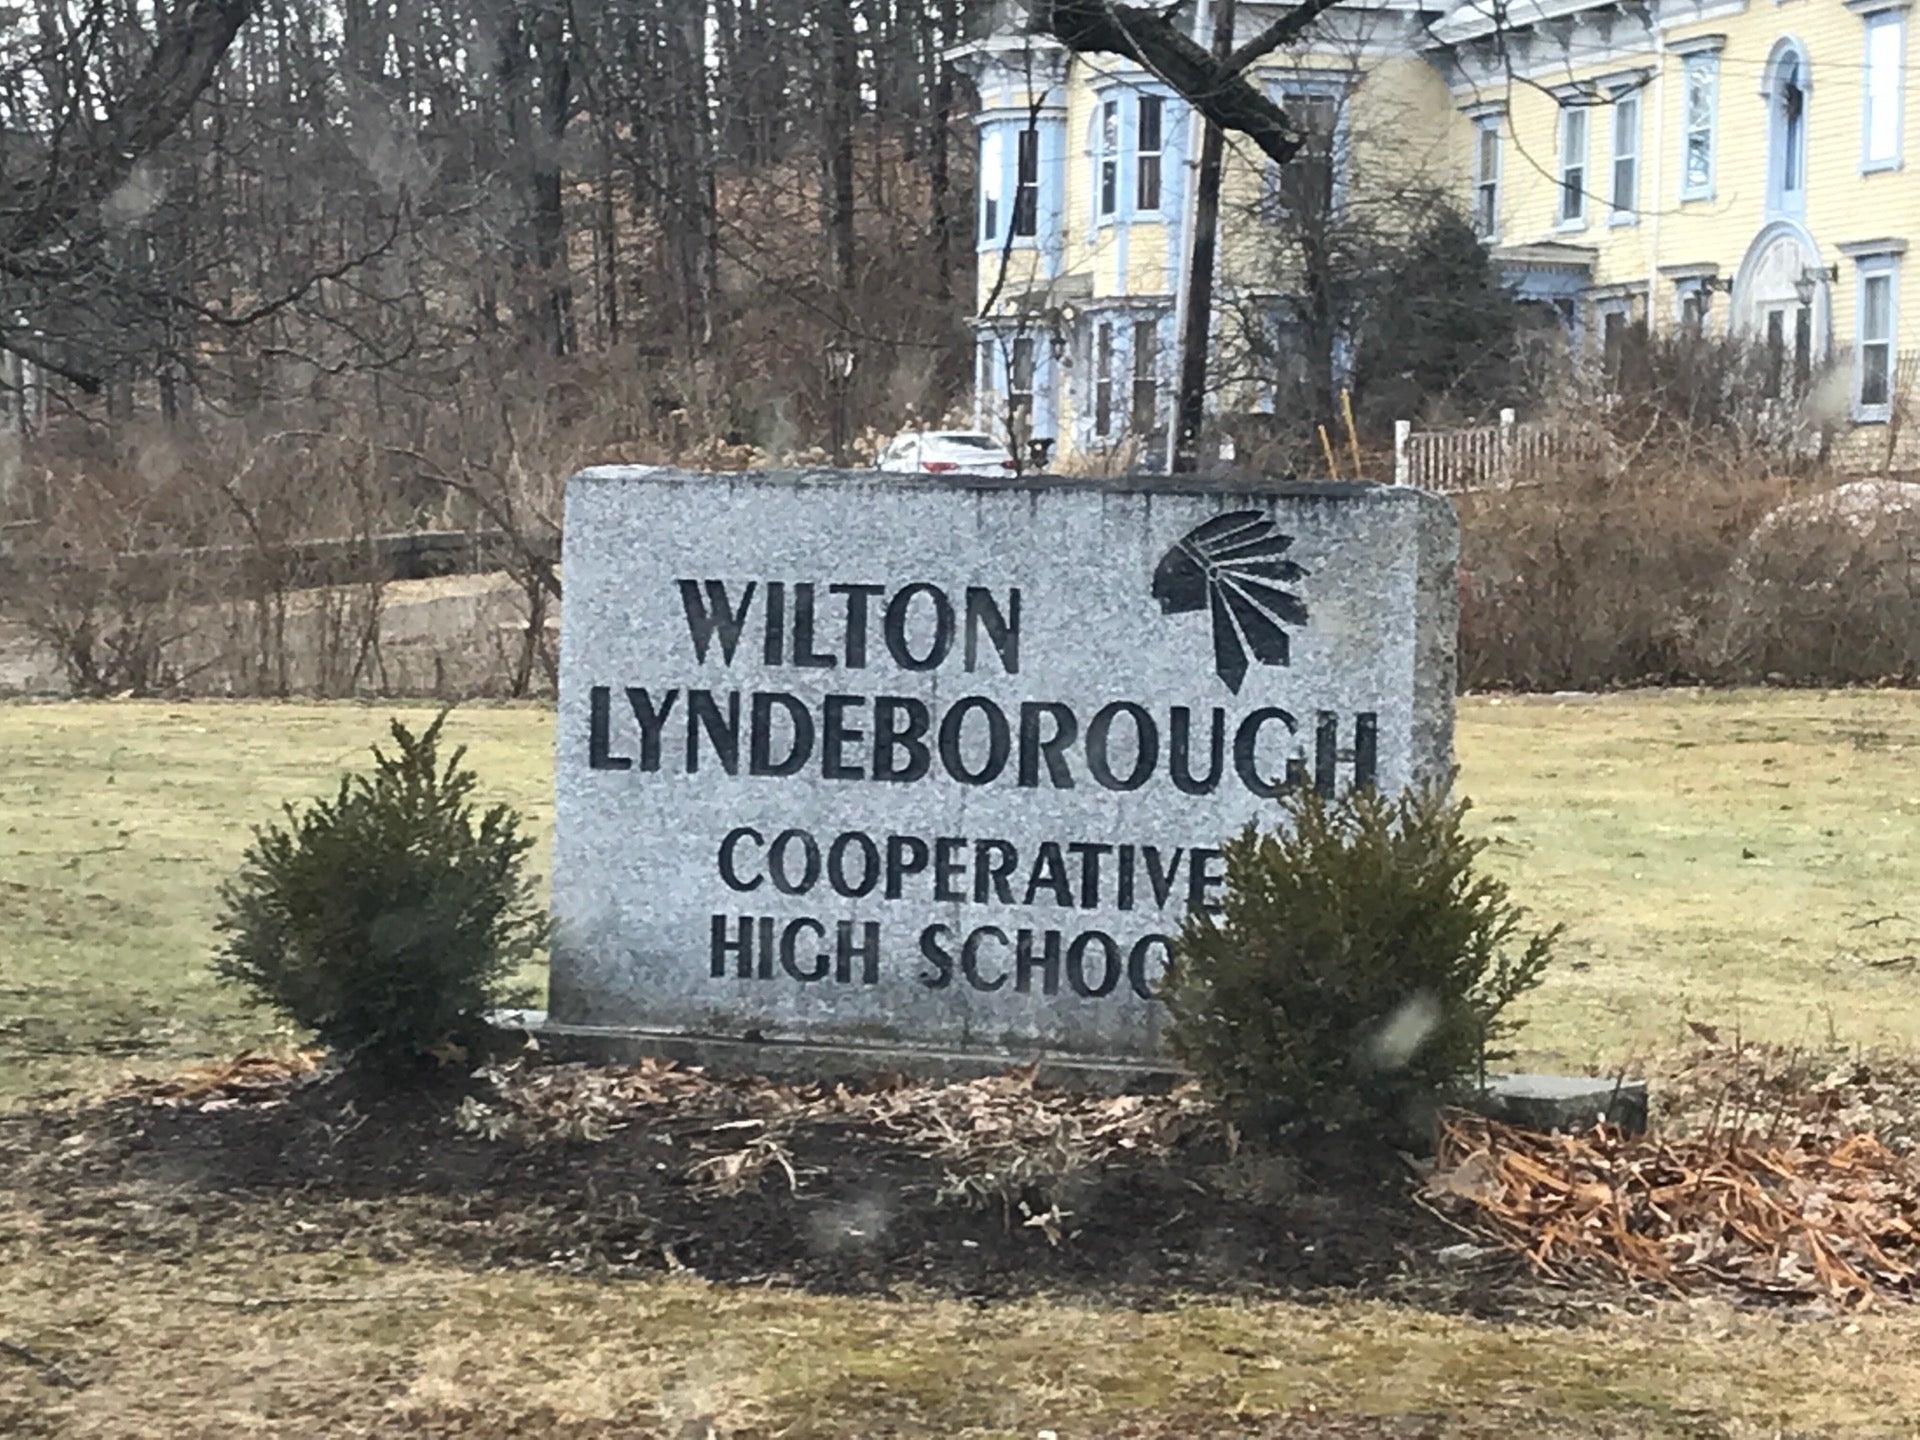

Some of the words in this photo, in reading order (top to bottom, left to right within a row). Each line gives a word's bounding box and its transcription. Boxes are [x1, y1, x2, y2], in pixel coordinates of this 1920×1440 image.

[676, 579, 1021, 674] WILTON
[589, 686, 1378, 800] LYNDEBOROUGH
[718, 827, 1227, 913] COOPERATIVE
[710, 914, 881, 985] HIGH
[919, 923, 1180, 1001] SCHOO
